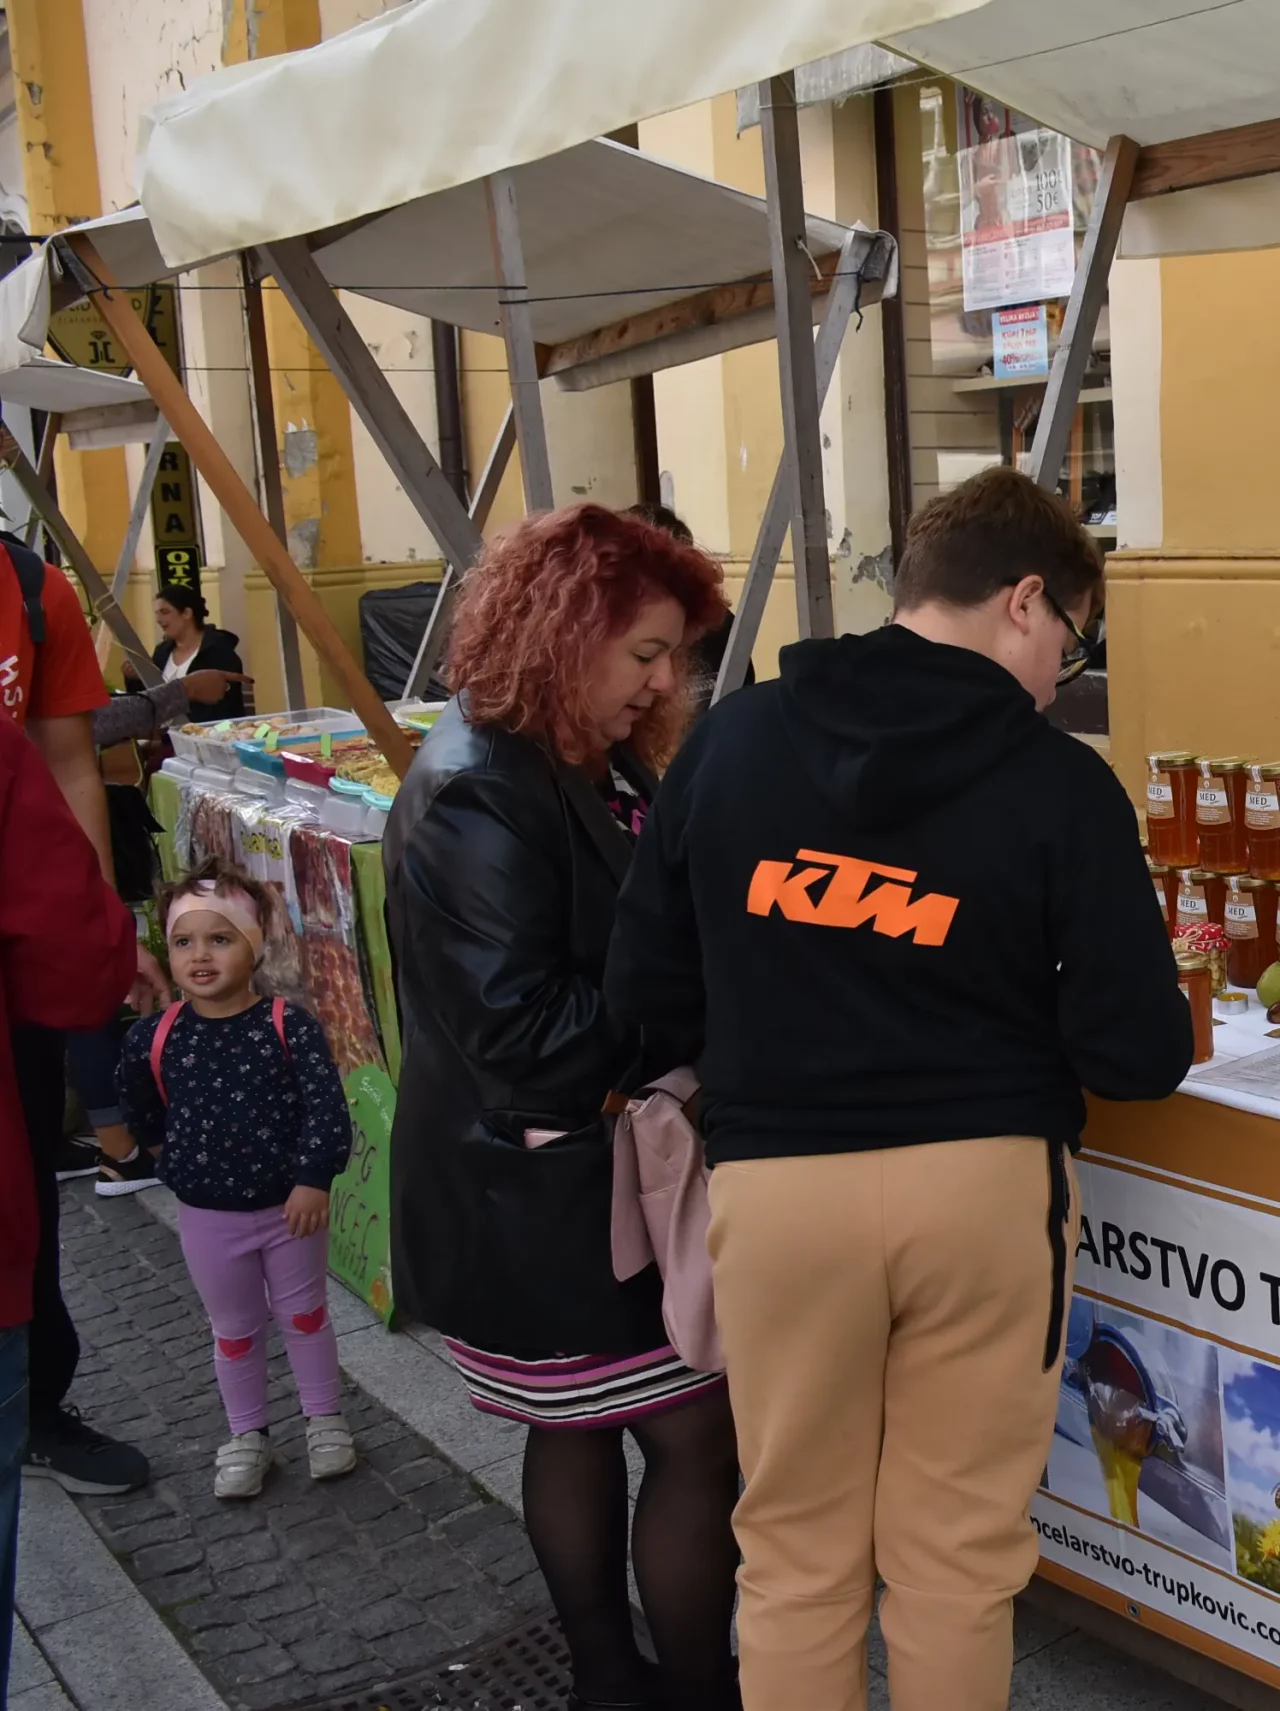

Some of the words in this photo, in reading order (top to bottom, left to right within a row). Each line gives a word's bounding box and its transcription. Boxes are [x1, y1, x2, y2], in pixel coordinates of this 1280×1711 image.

[1149, 785, 1163, 796] MED
[1200, 790, 1216, 802] MED
[1250, 795, 1267, 806] MED
[747, 848, 960, 946] KTM
[1181, 898, 1197, 909] MED
[1228, 906, 1245, 917] MED
